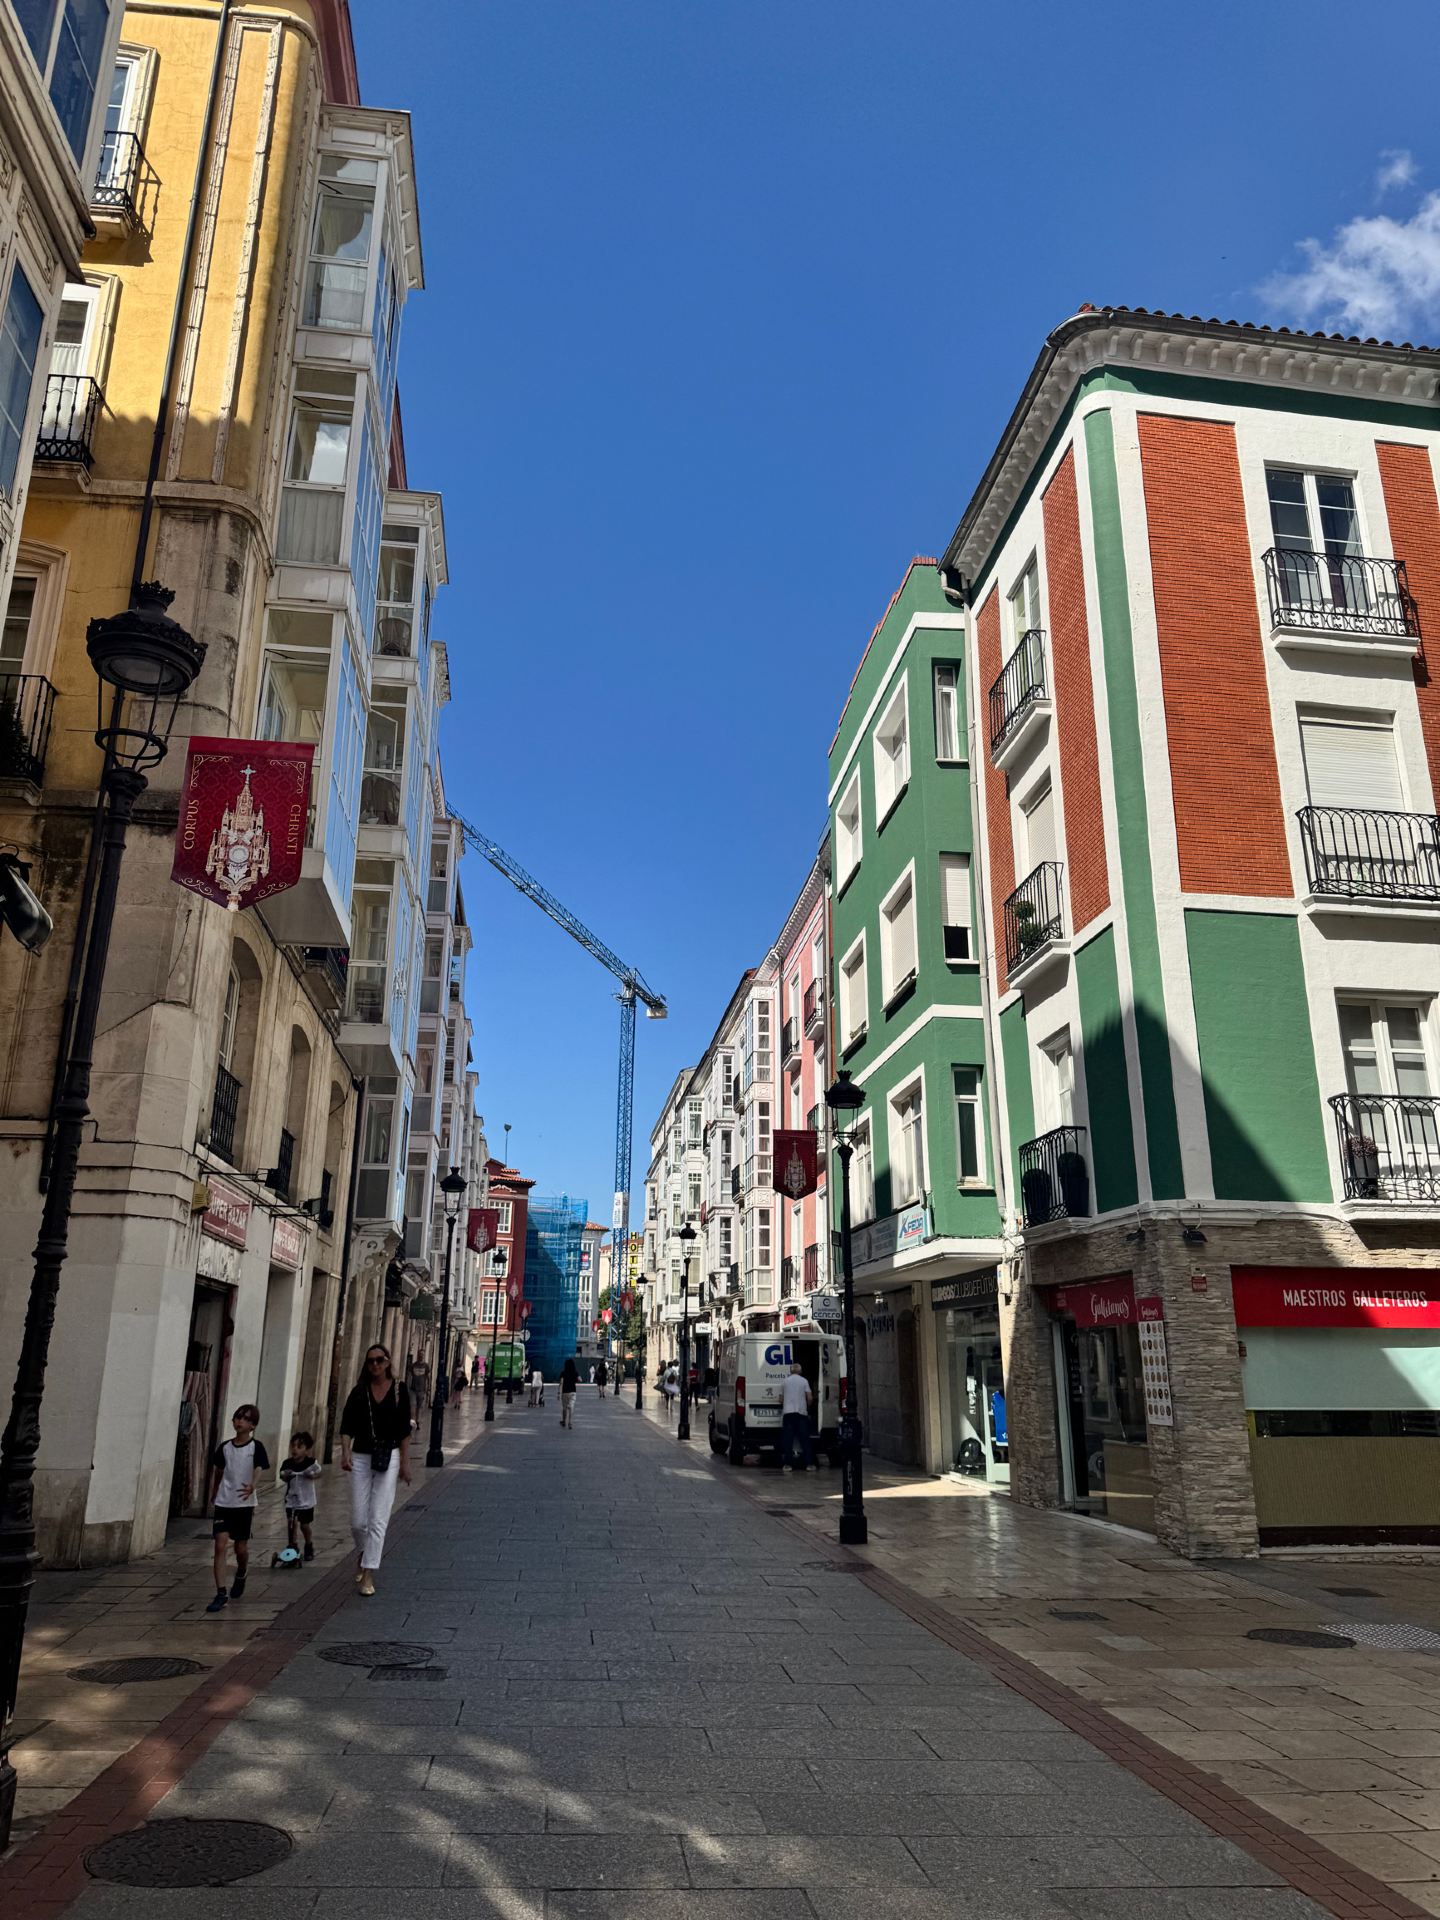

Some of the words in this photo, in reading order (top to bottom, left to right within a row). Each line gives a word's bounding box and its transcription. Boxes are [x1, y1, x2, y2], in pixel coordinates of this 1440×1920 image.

[183, 799, 200, 850] CORPUS
[286, 804, 302, 856] CHRISTI
[630, 1231, 638, 1288] HOTEL
[1283, 1289, 1347, 1307] MAESTROS
[1353, 1290, 1428, 1308] GALLETEROS
